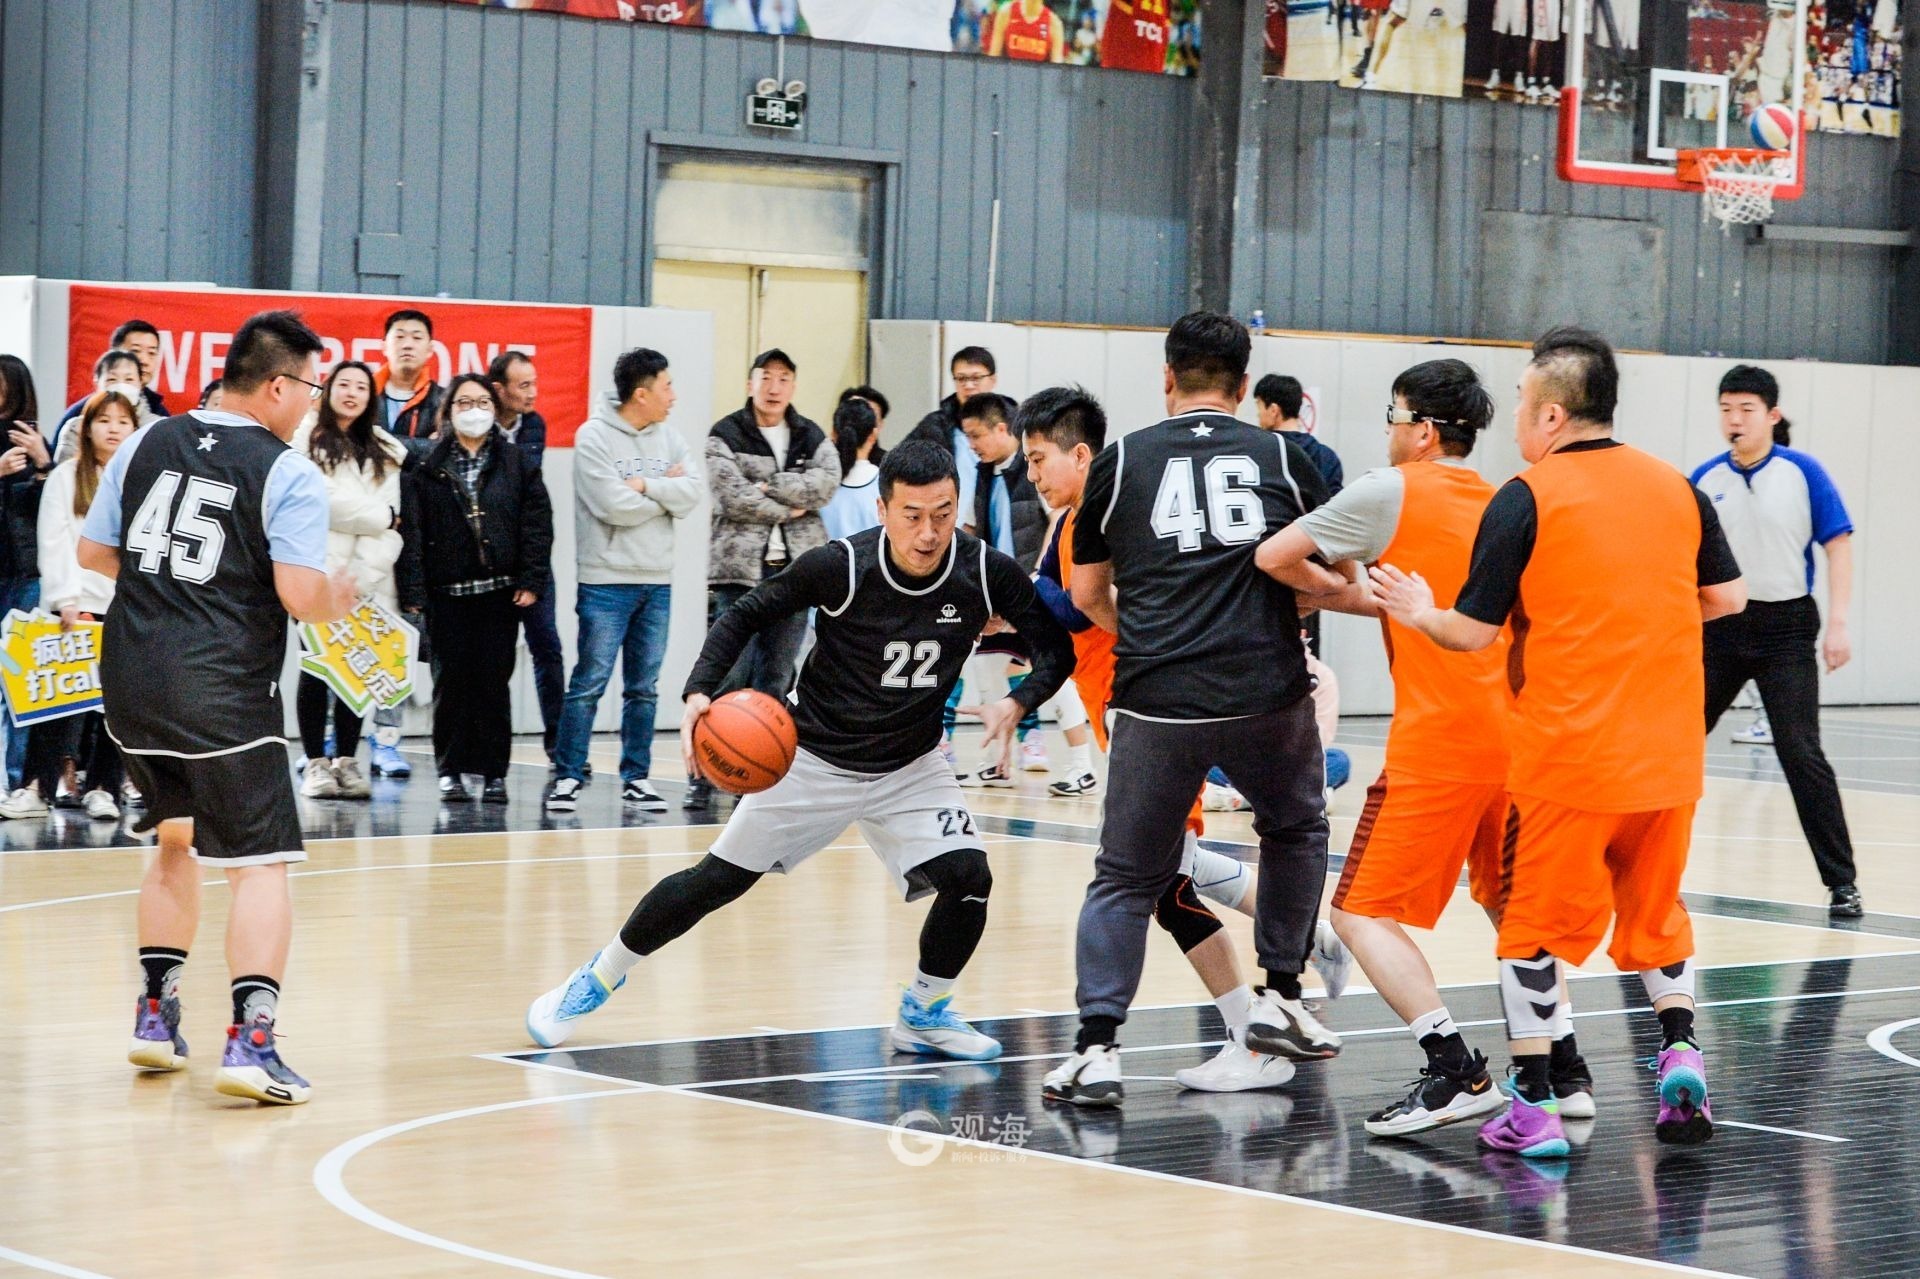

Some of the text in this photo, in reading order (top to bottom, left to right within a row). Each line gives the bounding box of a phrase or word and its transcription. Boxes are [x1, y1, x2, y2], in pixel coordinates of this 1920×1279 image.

[641, 2, 683, 22] TCL
[1134, 19, 1162, 43] TCL
[1150, 455, 1267, 552] 46
[126, 470, 238, 585] 45
[31, 629, 96, 667] 疯狂
[327, 618, 401, 705] 牛逼症
[881, 640, 941, 688] 22
[26, 662, 102, 703] 打cal
[938, 809, 974, 837] 22
